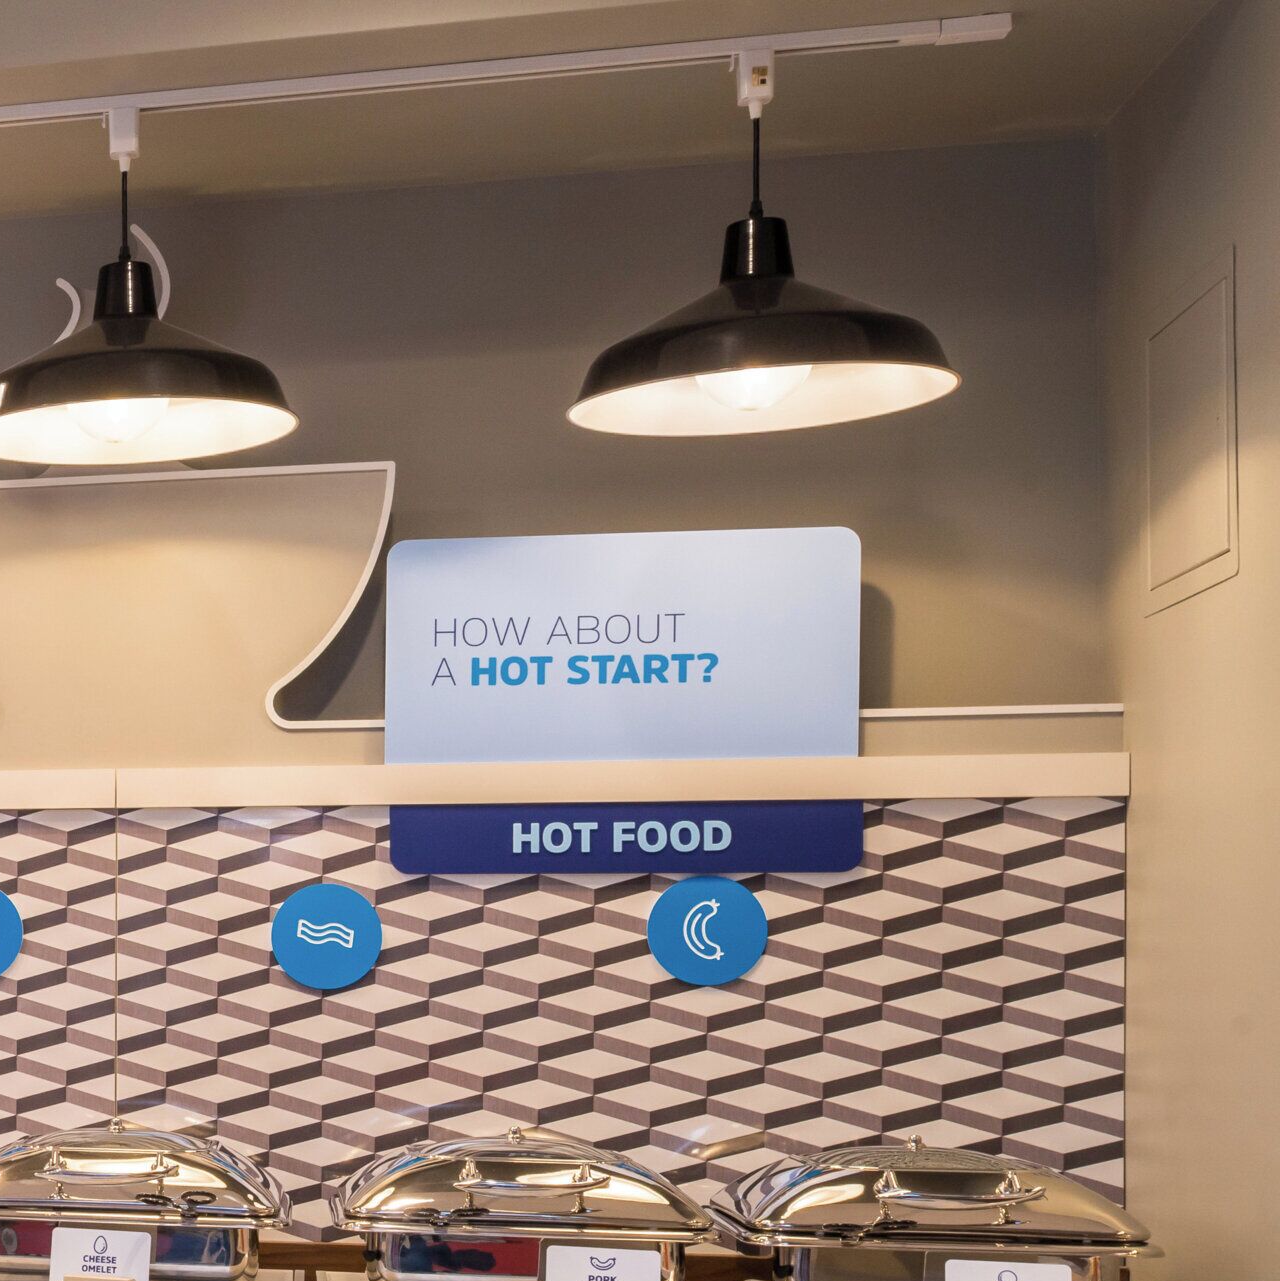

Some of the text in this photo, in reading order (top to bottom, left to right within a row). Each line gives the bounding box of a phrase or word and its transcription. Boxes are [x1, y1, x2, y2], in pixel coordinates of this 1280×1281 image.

[433, 613, 686, 648] HOW ABOUT
[431, 652, 720, 687] A HOT START?
[512, 820, 733, 855] HOT FOOD
[81, 1264, 117, 1274] OMELET
[82, 1254, 117, 1264] CHEESE
